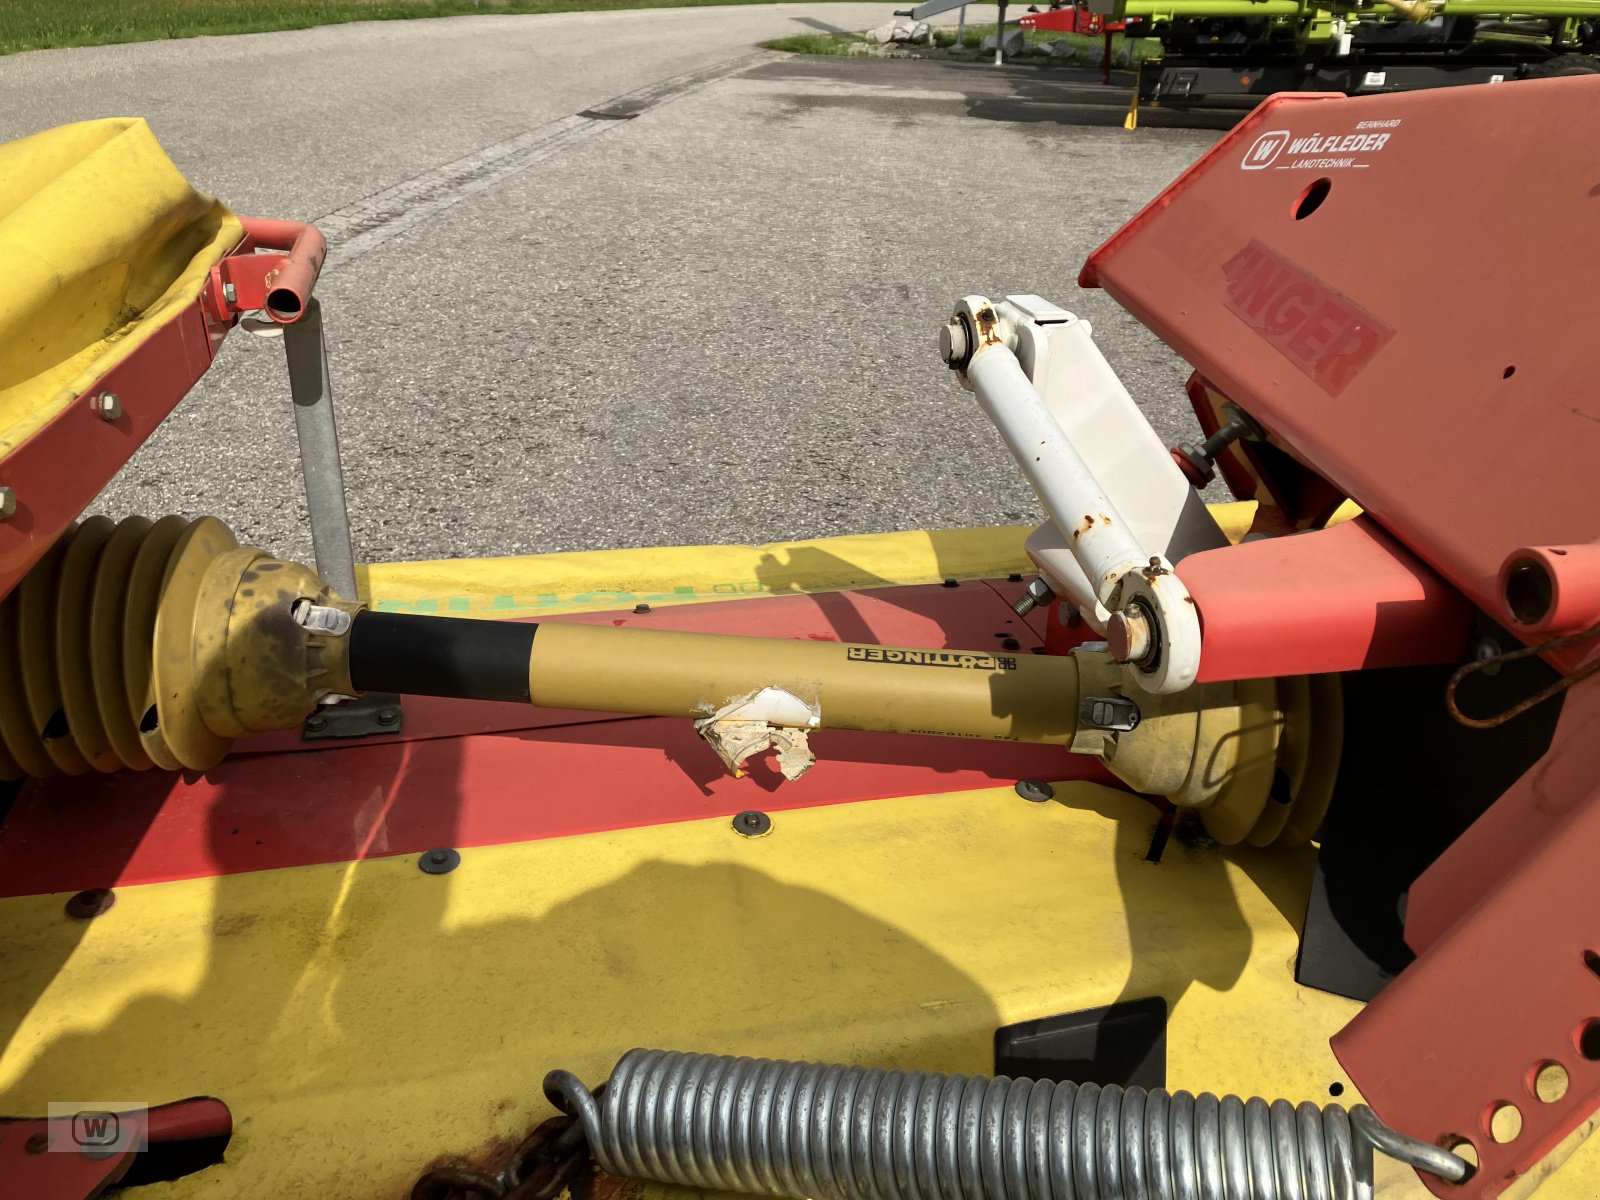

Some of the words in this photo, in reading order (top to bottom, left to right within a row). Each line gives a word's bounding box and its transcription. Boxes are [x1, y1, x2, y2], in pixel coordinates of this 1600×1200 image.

[1355, 119, 1402, 130] BERNHARD
[1252, 139, 1281, 161] W
[1287, 132, 1391, 154] WÖLFLEDER
[1290, 157, 1356, 169] LANDTECHNIK
[1223, 245, 1381, 389] INGER
[848, 647, 997, 670] PÖTTINGER
